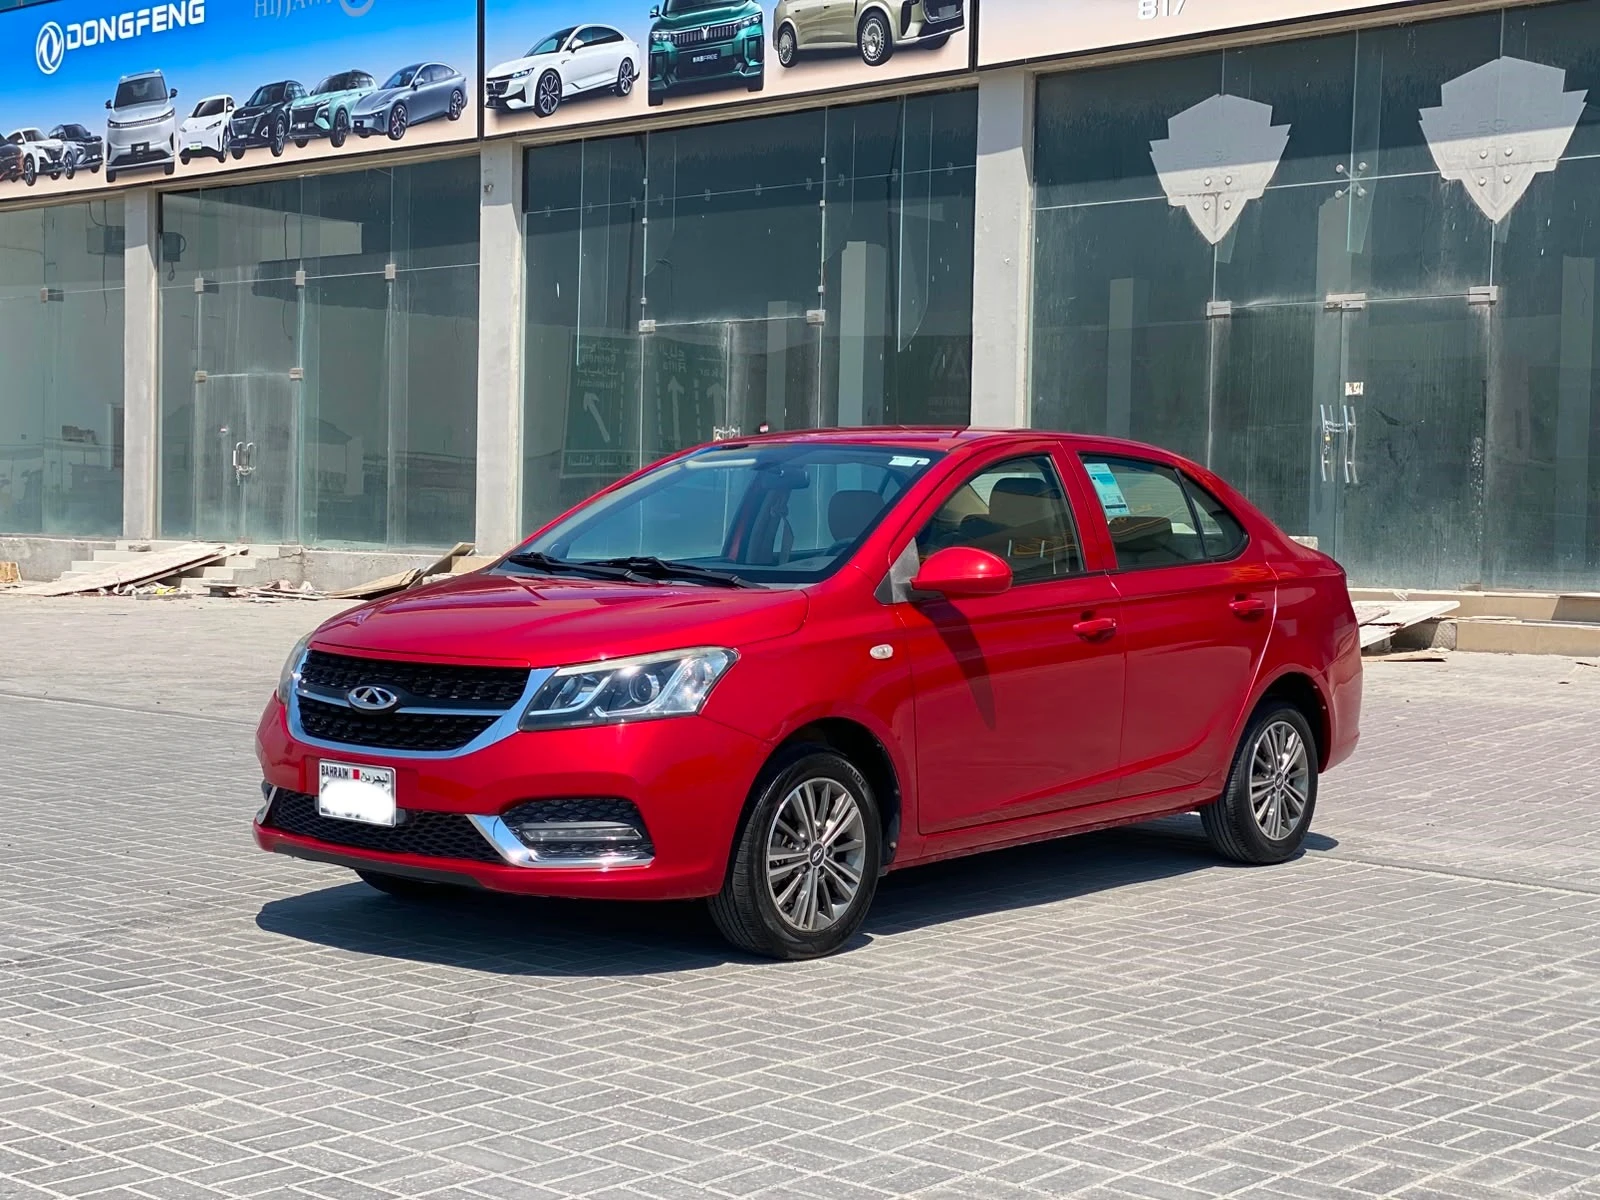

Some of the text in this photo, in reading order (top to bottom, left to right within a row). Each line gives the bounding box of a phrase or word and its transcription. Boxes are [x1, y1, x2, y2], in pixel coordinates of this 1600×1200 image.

[66, 0, 205, 50] DONGFENG
[321, 765, 349, 779] BAHRAIN
[360, 772, 389, 787] البحرين
